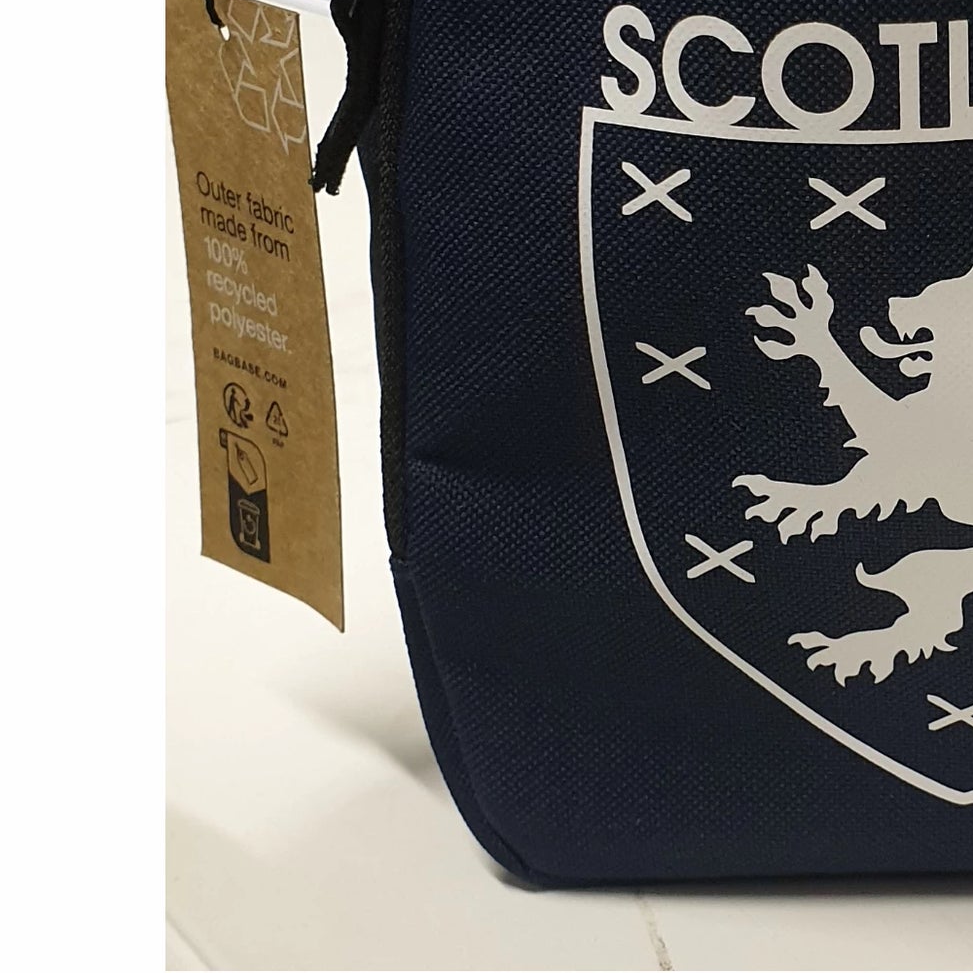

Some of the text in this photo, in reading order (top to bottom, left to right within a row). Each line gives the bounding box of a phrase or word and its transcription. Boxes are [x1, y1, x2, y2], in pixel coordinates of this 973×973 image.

[196, 170, 295, 235] Outer fabric
[200, 206, 291, 263] made from
[203, 234, 249, 276] 100%
[206, 269, 278, 317] recycled
[209, 301, 293, 355] polyester.
[213, 346, 287, 389] BAGBASE.COM
